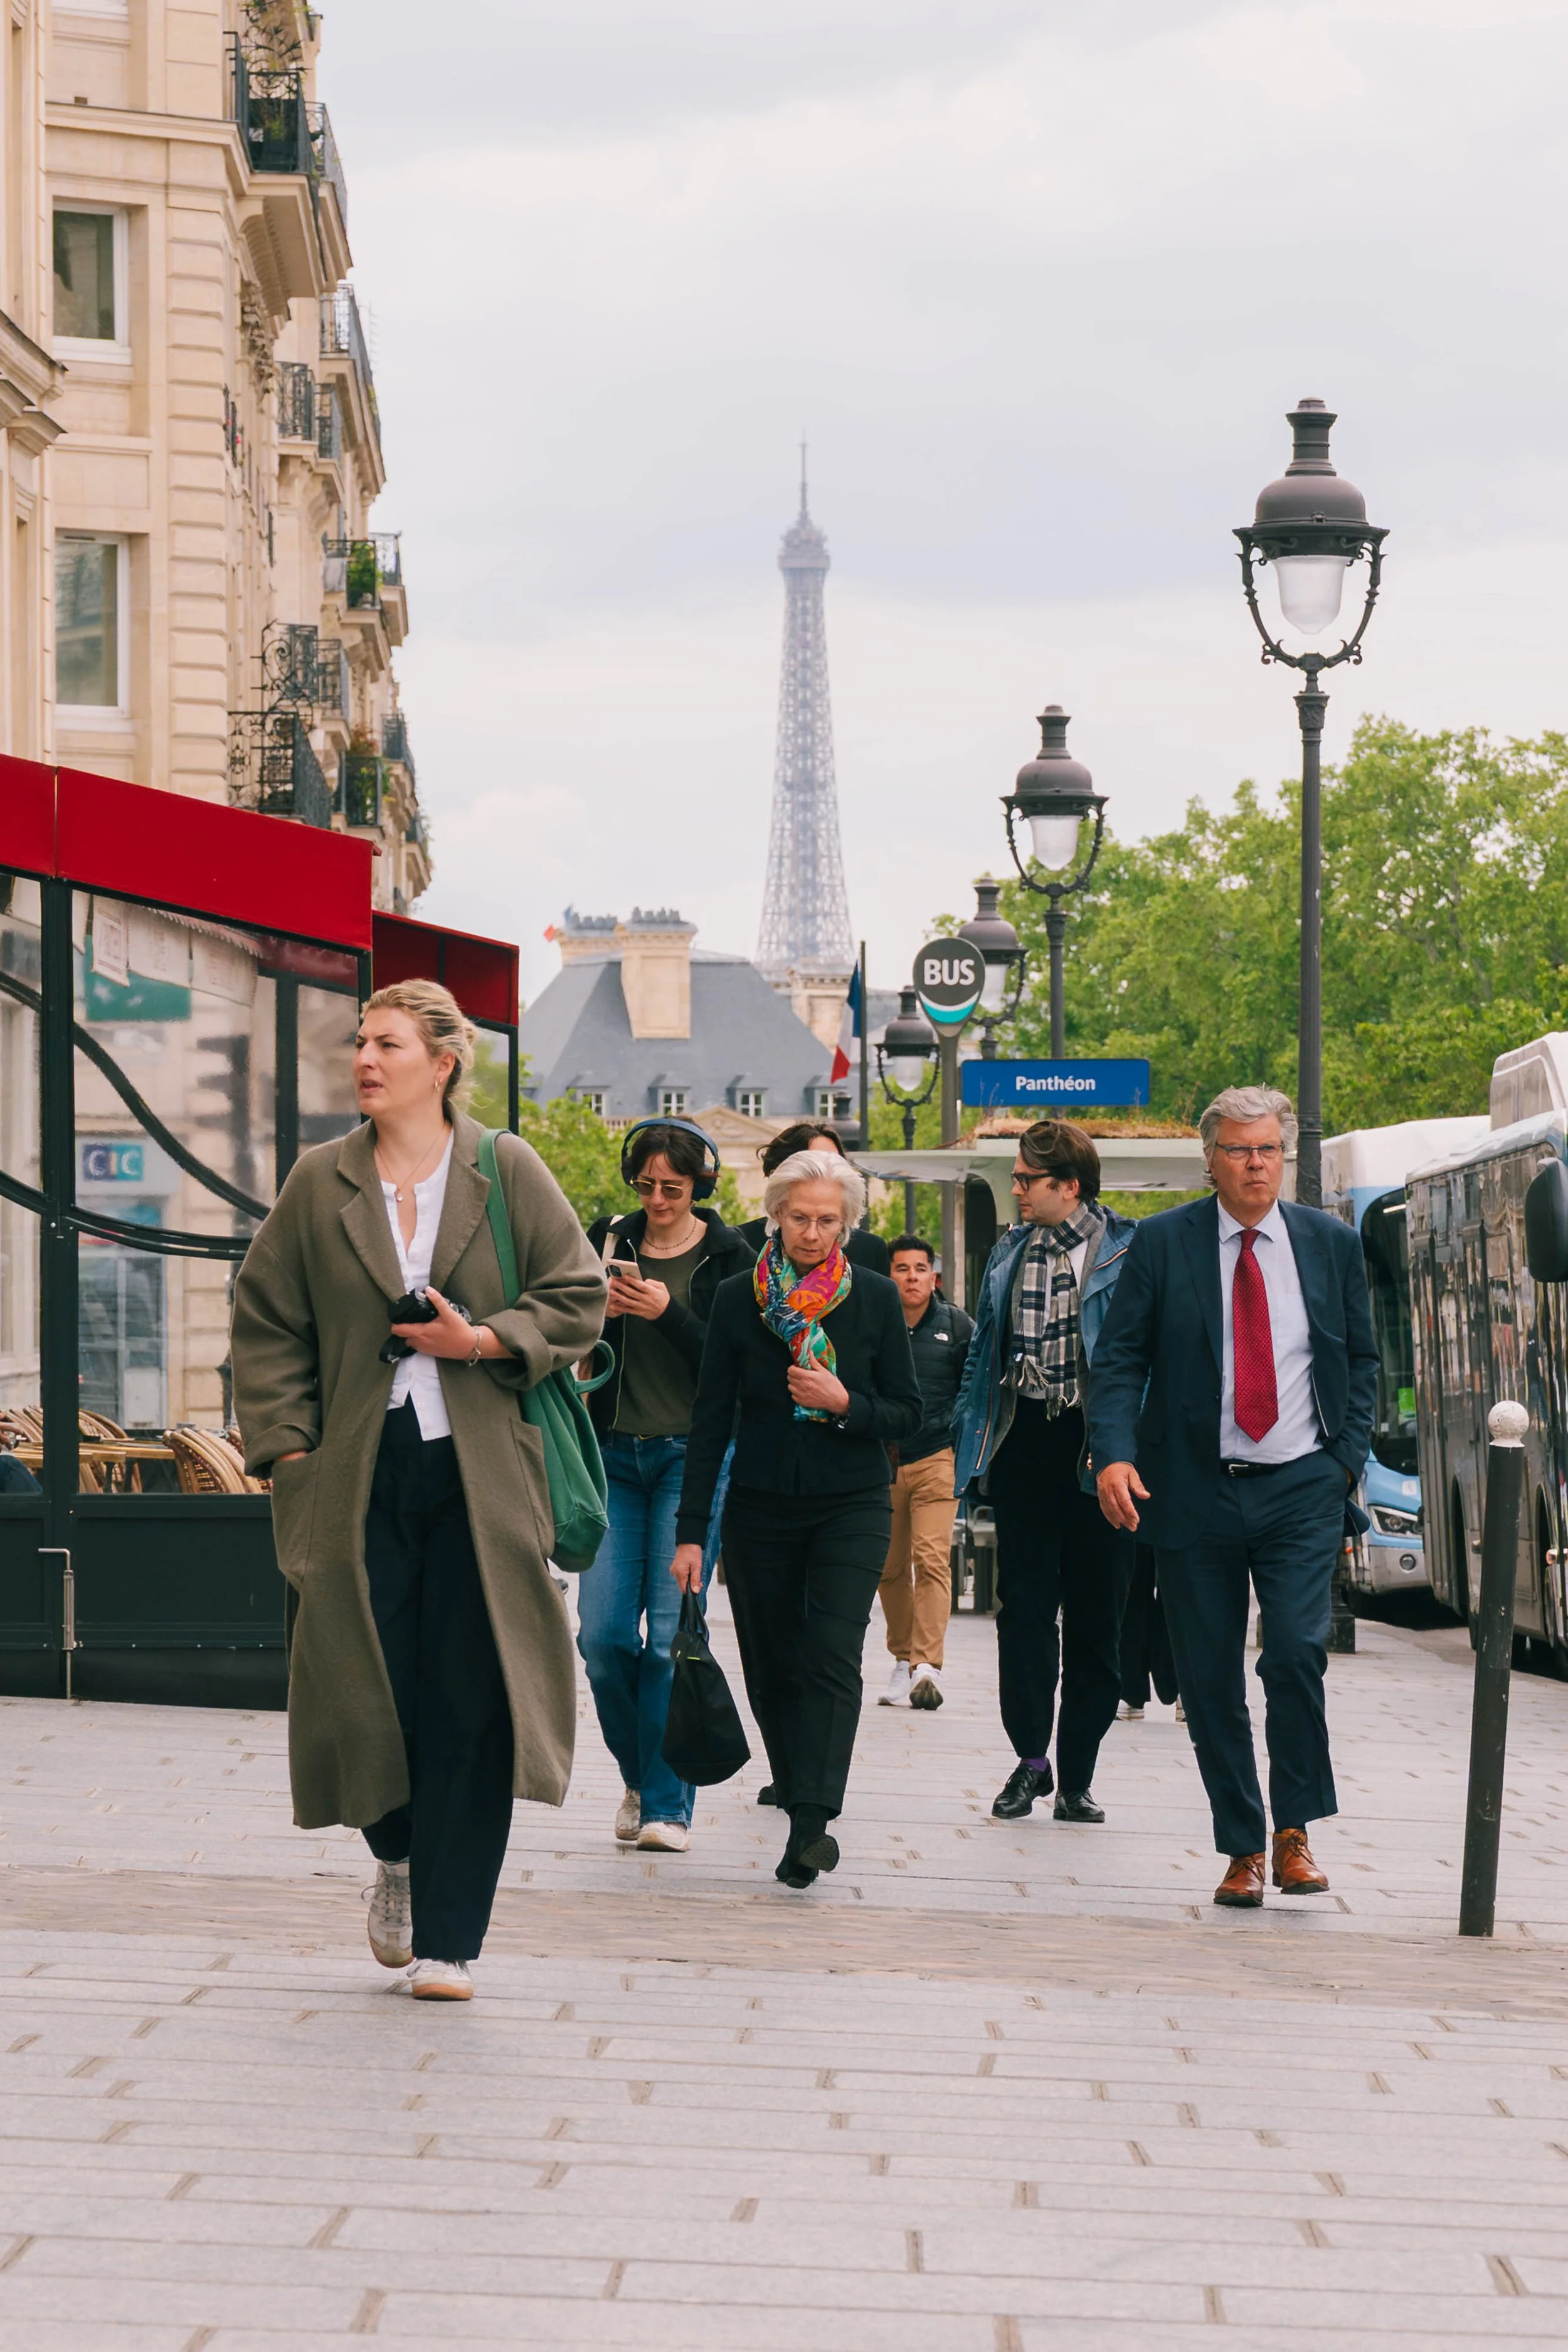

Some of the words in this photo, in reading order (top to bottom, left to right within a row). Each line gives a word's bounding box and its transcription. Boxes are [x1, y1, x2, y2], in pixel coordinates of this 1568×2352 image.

[924, 958, 975, 985] BUS
[1015, 1075, 1096, 1091] Panthéon
[89, 1149, 140, 1176] CIC
